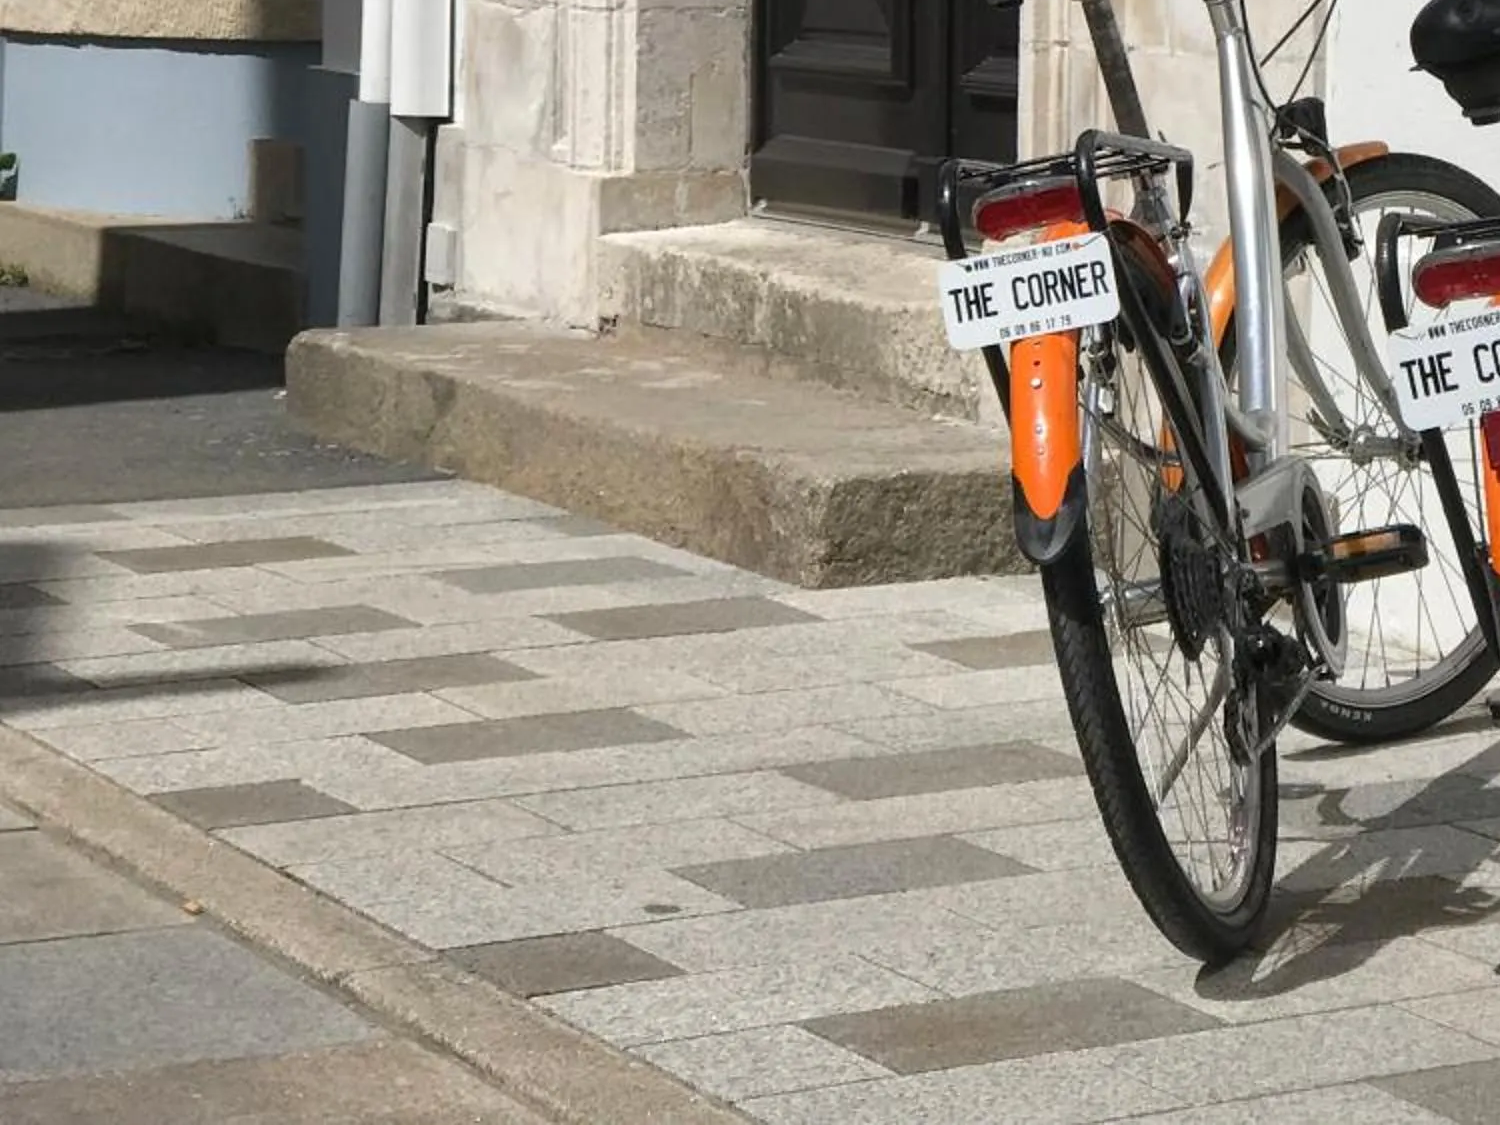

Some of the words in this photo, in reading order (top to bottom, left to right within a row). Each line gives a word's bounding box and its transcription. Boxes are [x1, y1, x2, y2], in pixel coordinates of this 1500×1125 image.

[948, 282, 999, 324] THE
[1011, 260, 1110, 311] CORNER
[1399, 350, 1460, 401] THE
[1319, 699, 1374, 724] KENDA
